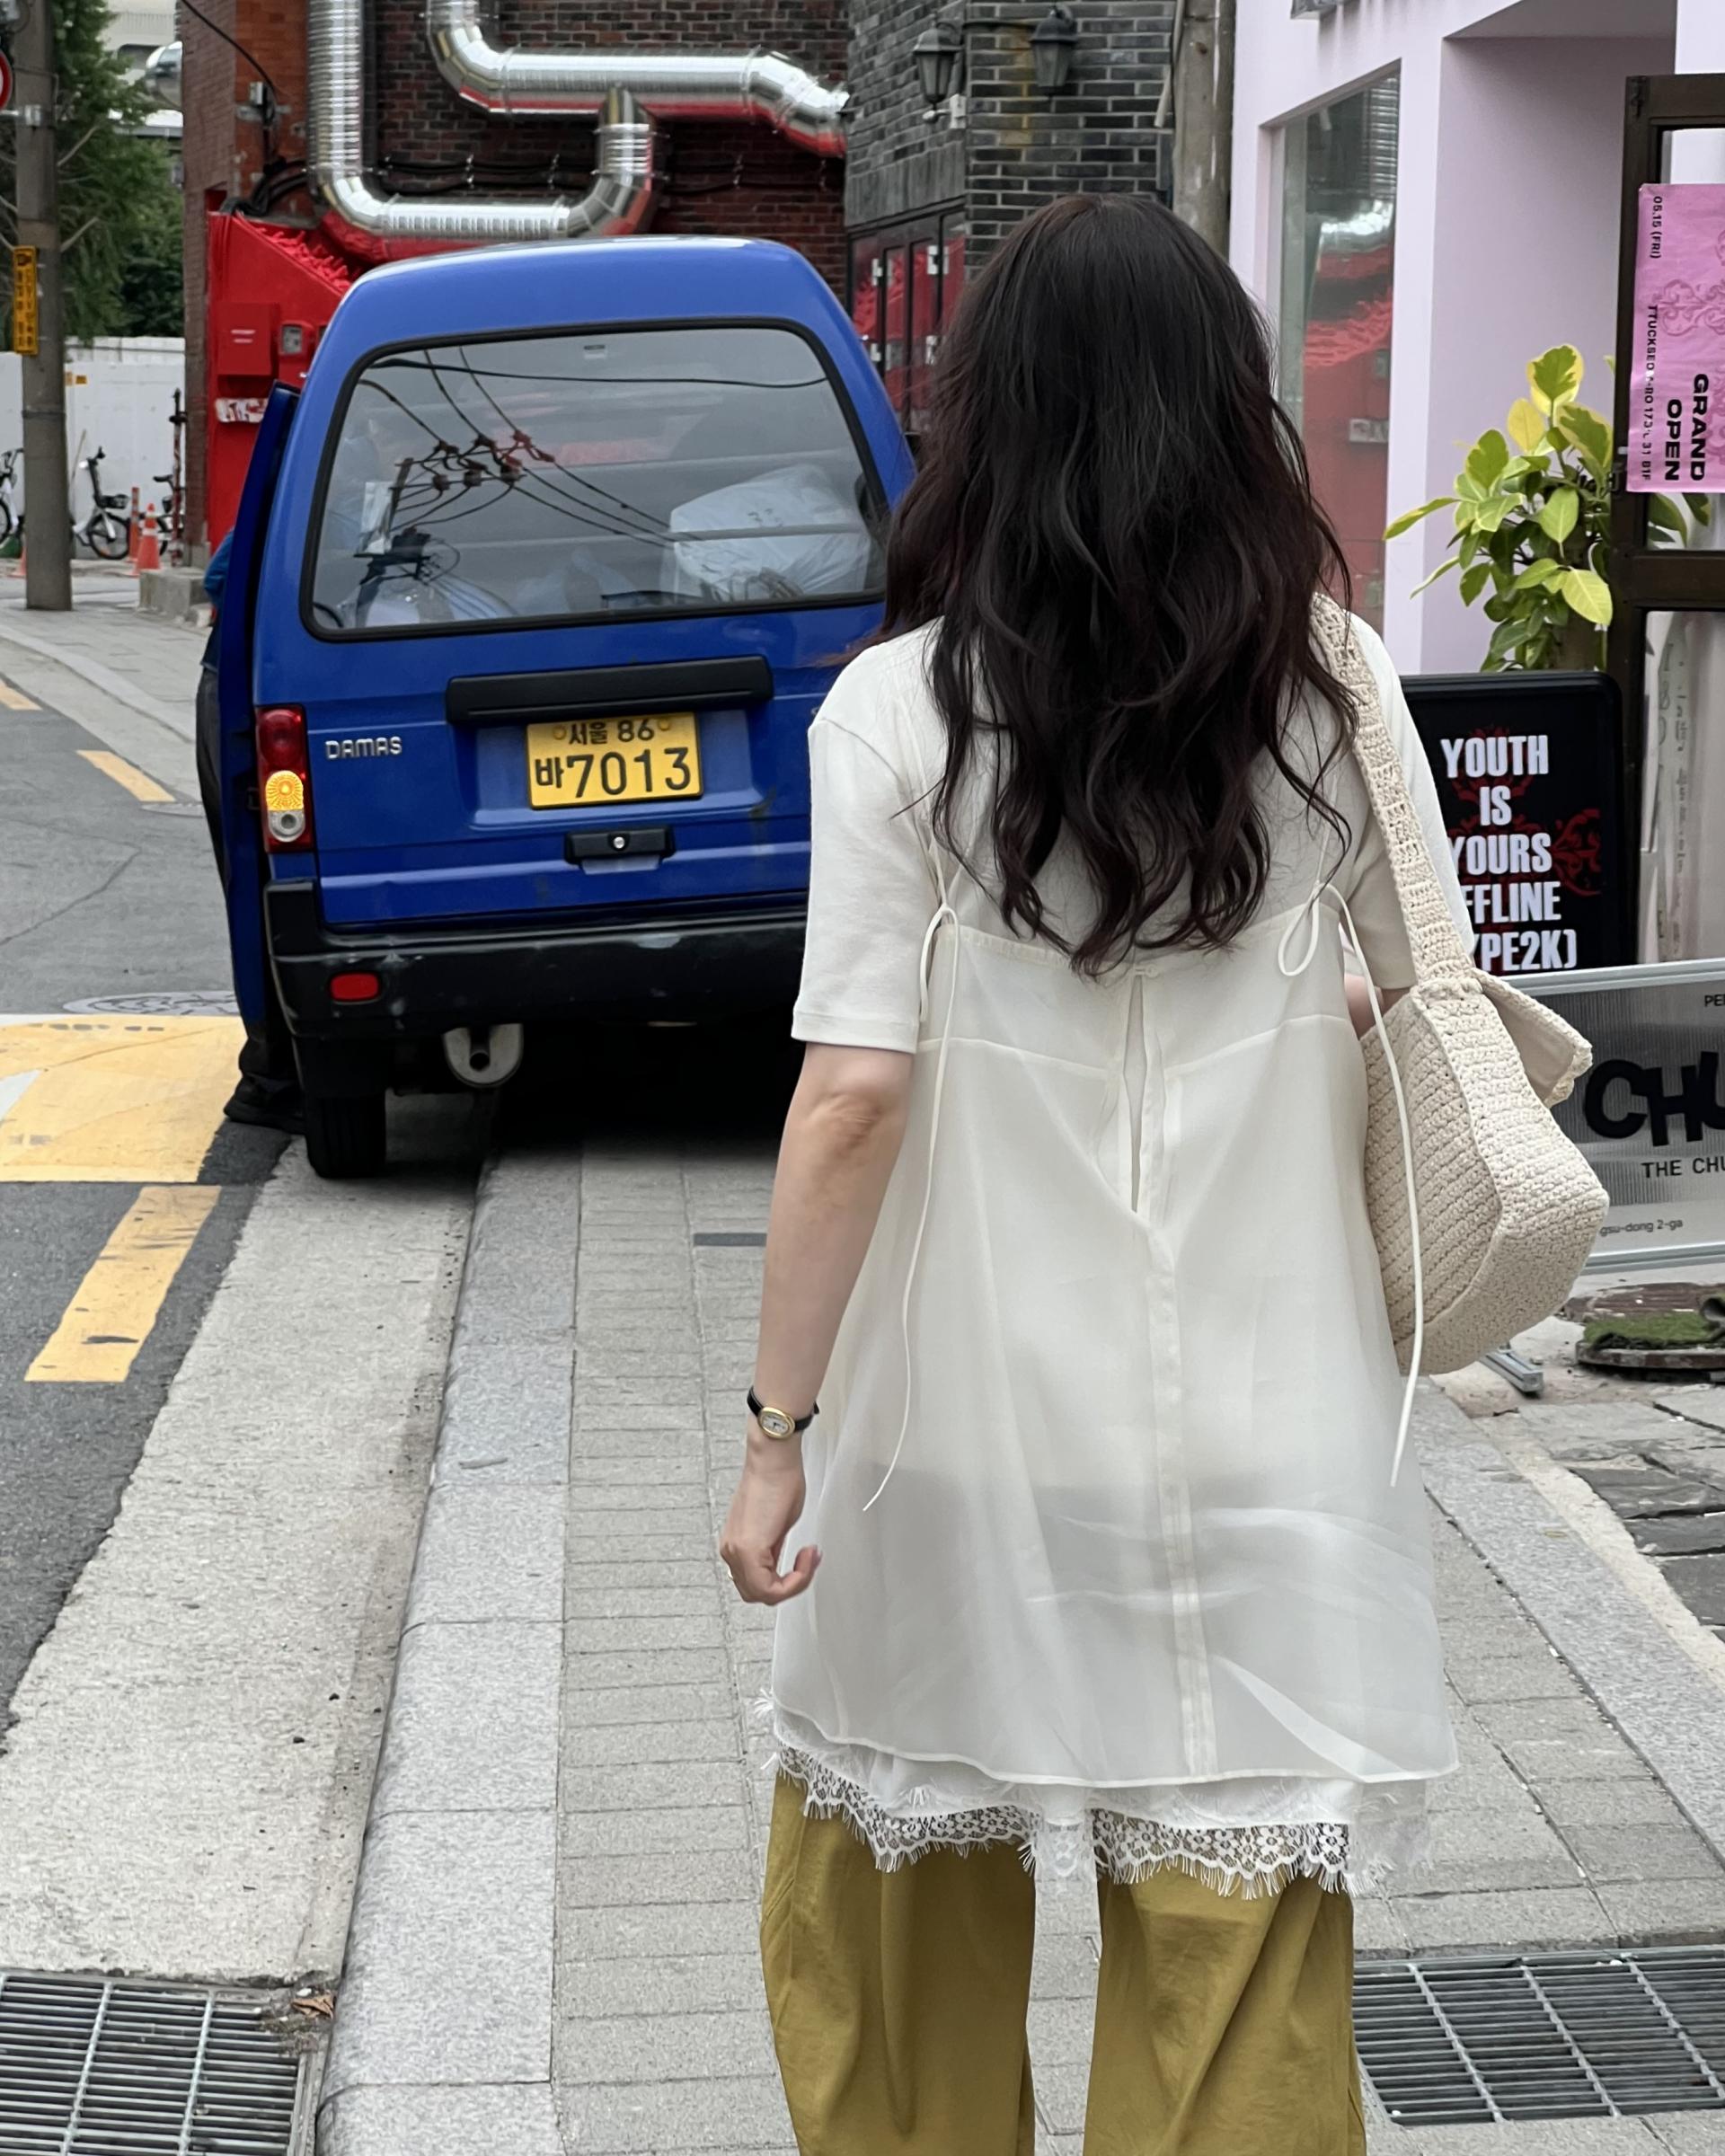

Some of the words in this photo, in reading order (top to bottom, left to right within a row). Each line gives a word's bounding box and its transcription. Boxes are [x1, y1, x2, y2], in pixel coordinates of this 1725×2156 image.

[1650, 231, 1662, 259] (FRI)
[1665, 399, 1682, 481] OPEN
[1690, 373, 1709, 481] GRAND
[325, 737, 402, 759] DAMAS
[569, 721, 607, 745] 서울
[617, 720, 654, 742] 86
[1441, 735, 1549, 778] YOUTH
[1480, 785, 1512, 826] IS
[1447, 833, 1552, 875] YOURS
[1704, 994, 1725, 1007] PE
[1641, 1160, 1682, 1178] THE
